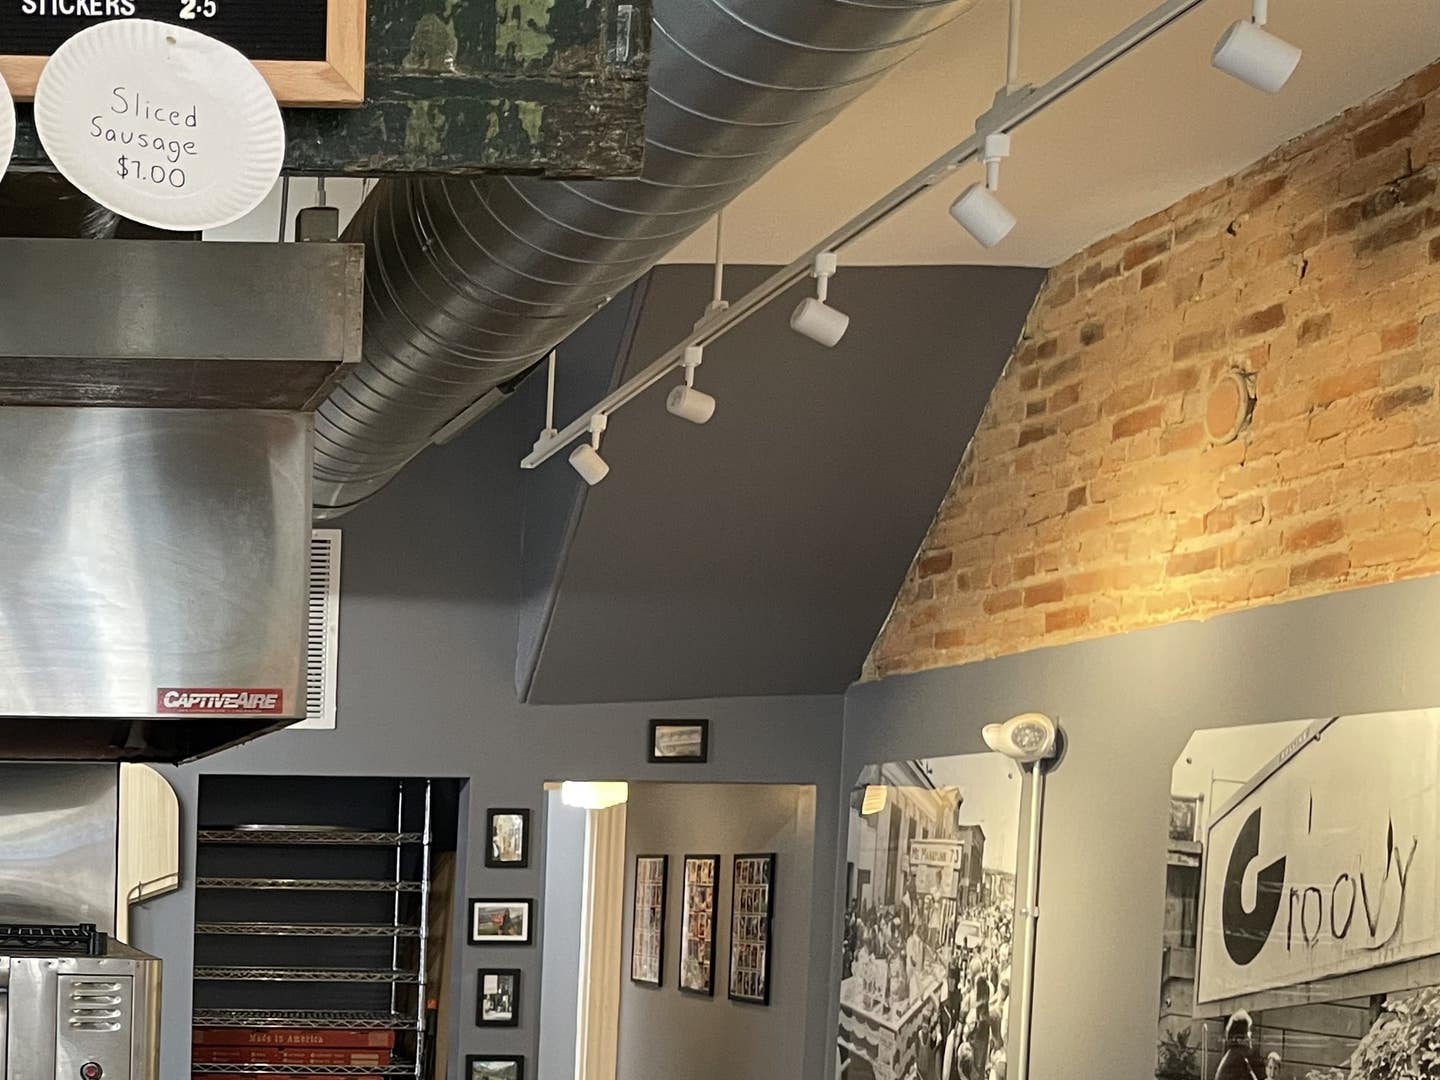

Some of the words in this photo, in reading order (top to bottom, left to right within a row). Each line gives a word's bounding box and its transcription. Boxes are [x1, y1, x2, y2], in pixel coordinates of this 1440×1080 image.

[111, 86, 197, 128] Sliced
[90, 115, 198, 163] Sausage
[117, 155, 185, 188] $7.00
[163, 690, 278, 709] CAPTIVEAIRE
[249, 1033, 271, 1043] Made
[274, 1033, 284, 1043] in
[287, 1034, 324, 1044] America
